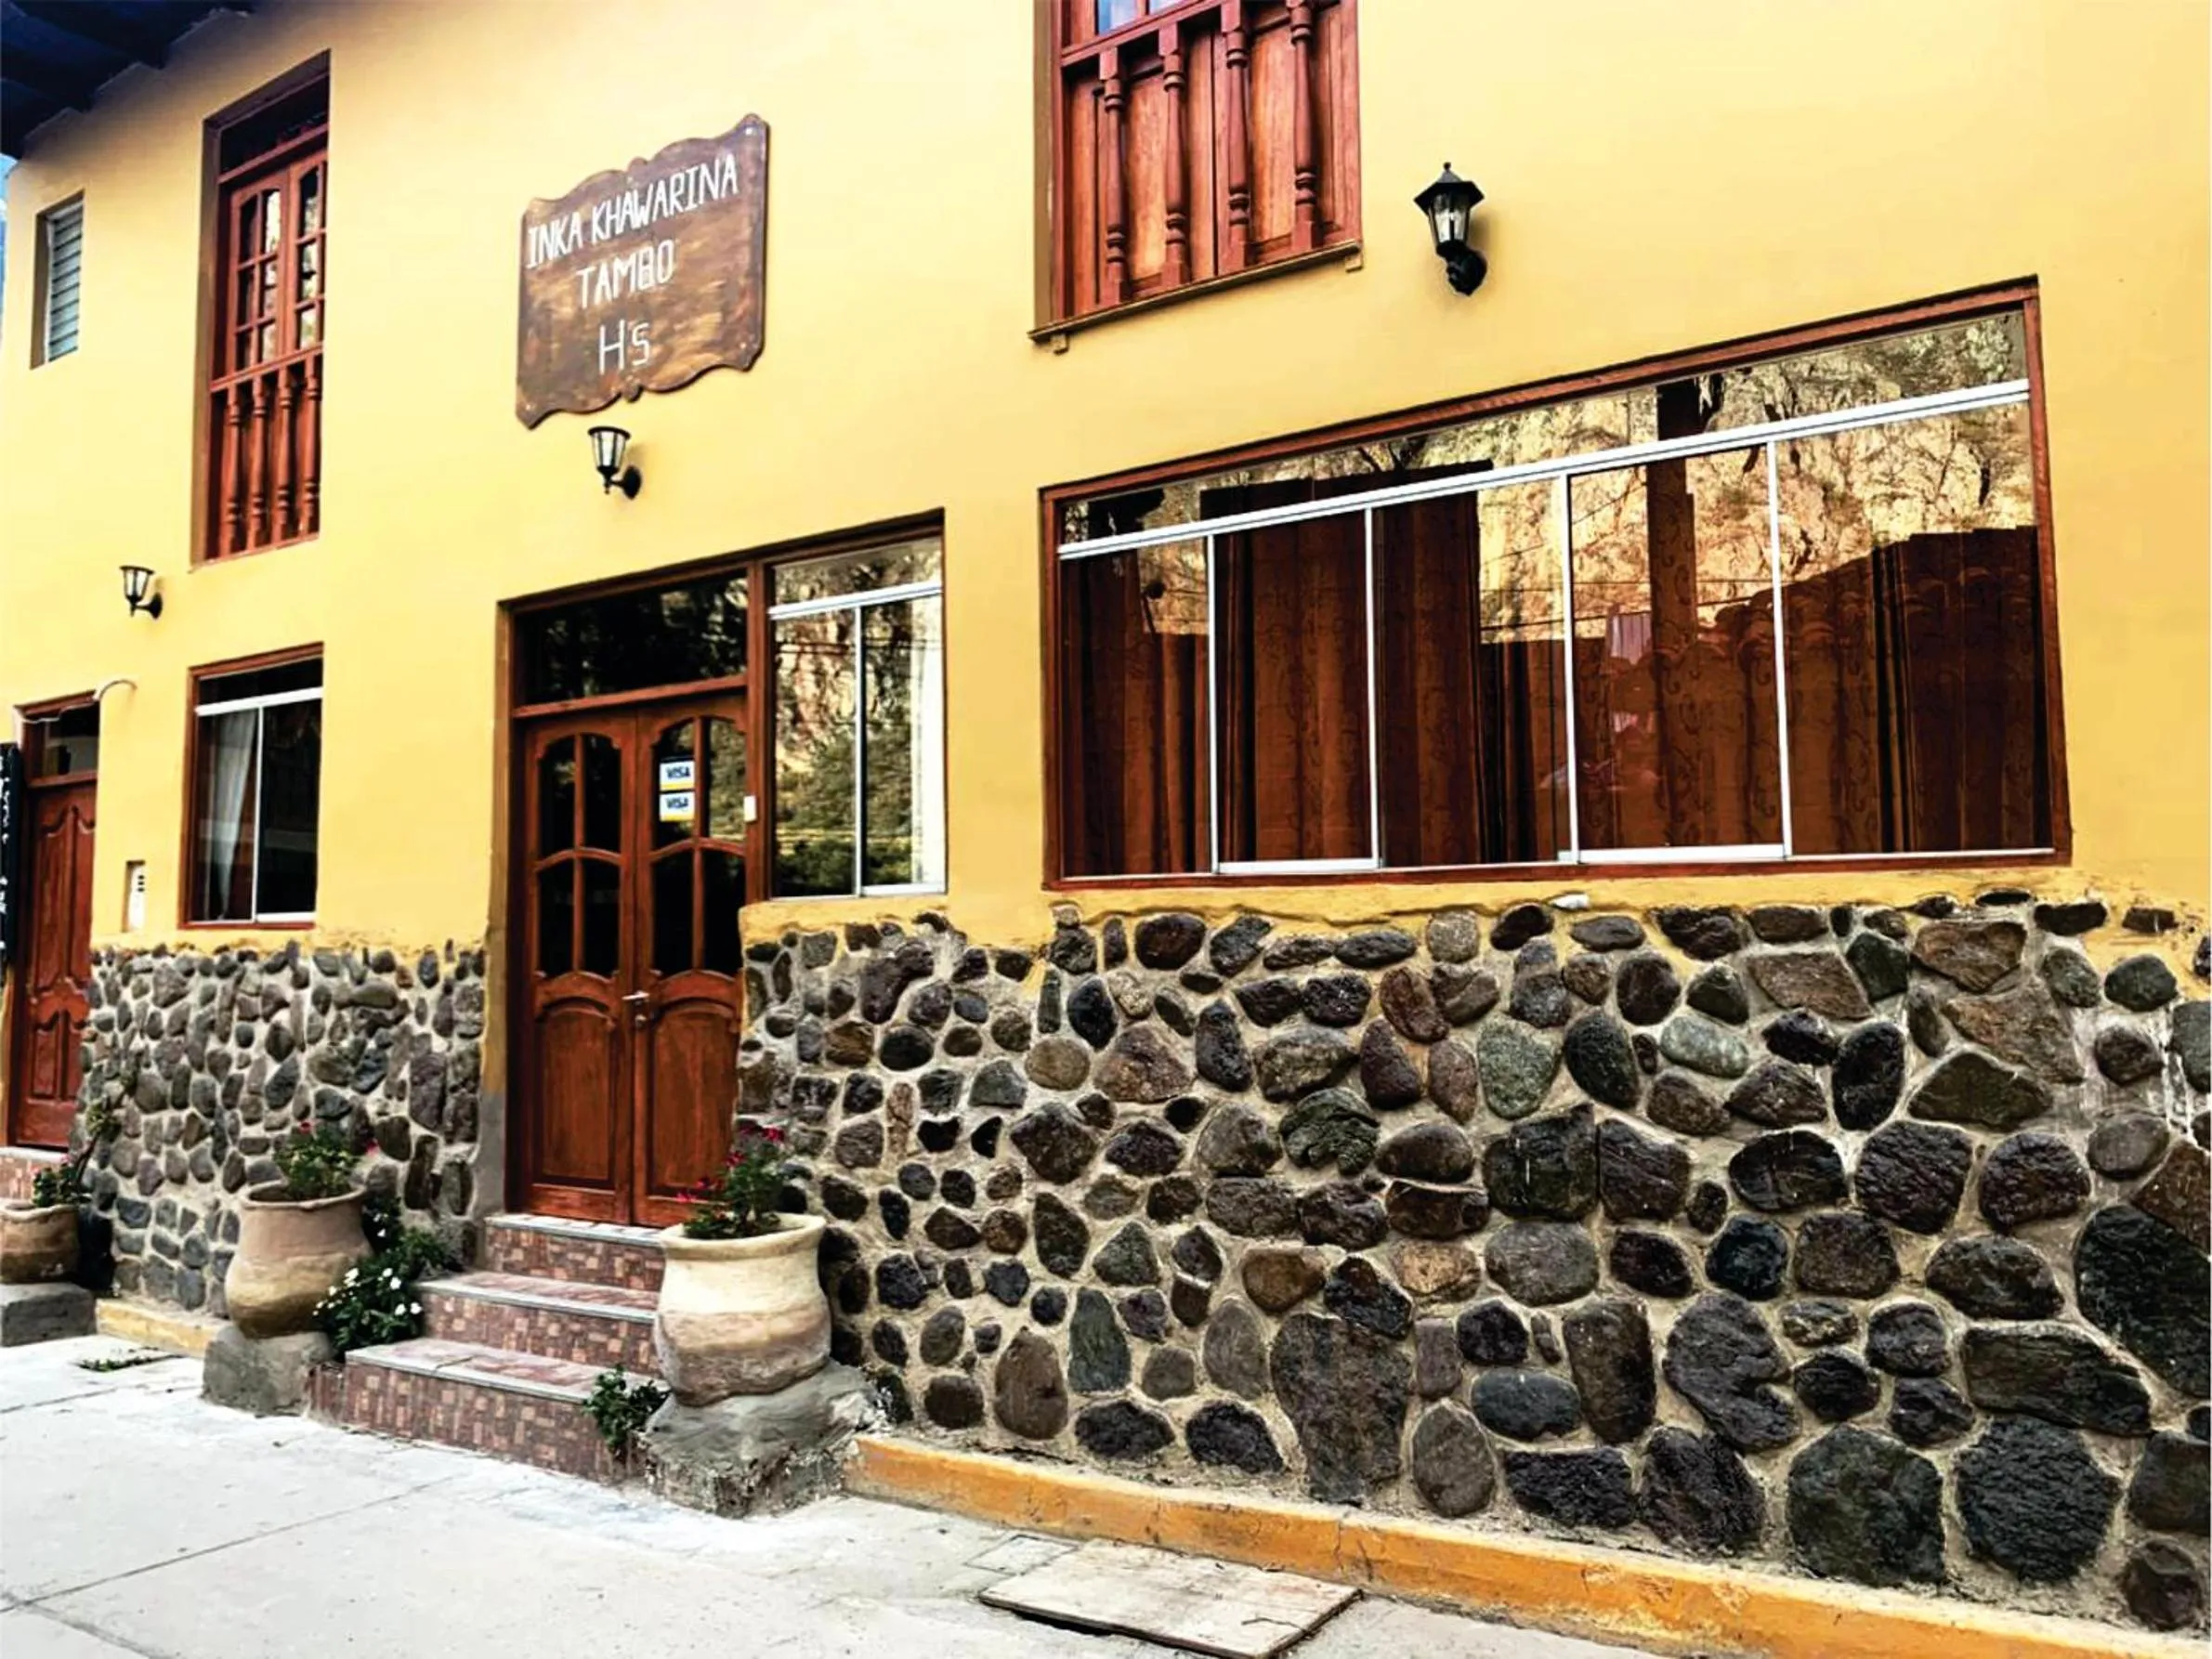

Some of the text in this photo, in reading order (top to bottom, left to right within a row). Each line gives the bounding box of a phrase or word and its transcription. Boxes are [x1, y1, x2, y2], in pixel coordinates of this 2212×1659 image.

[525, 153, 739, 269] INKA KHAWARINA
[576, 239, 675, 309] TAMBO
[666, 766, 690, 778] VISA
[665, 796, 689, 809] VISA
